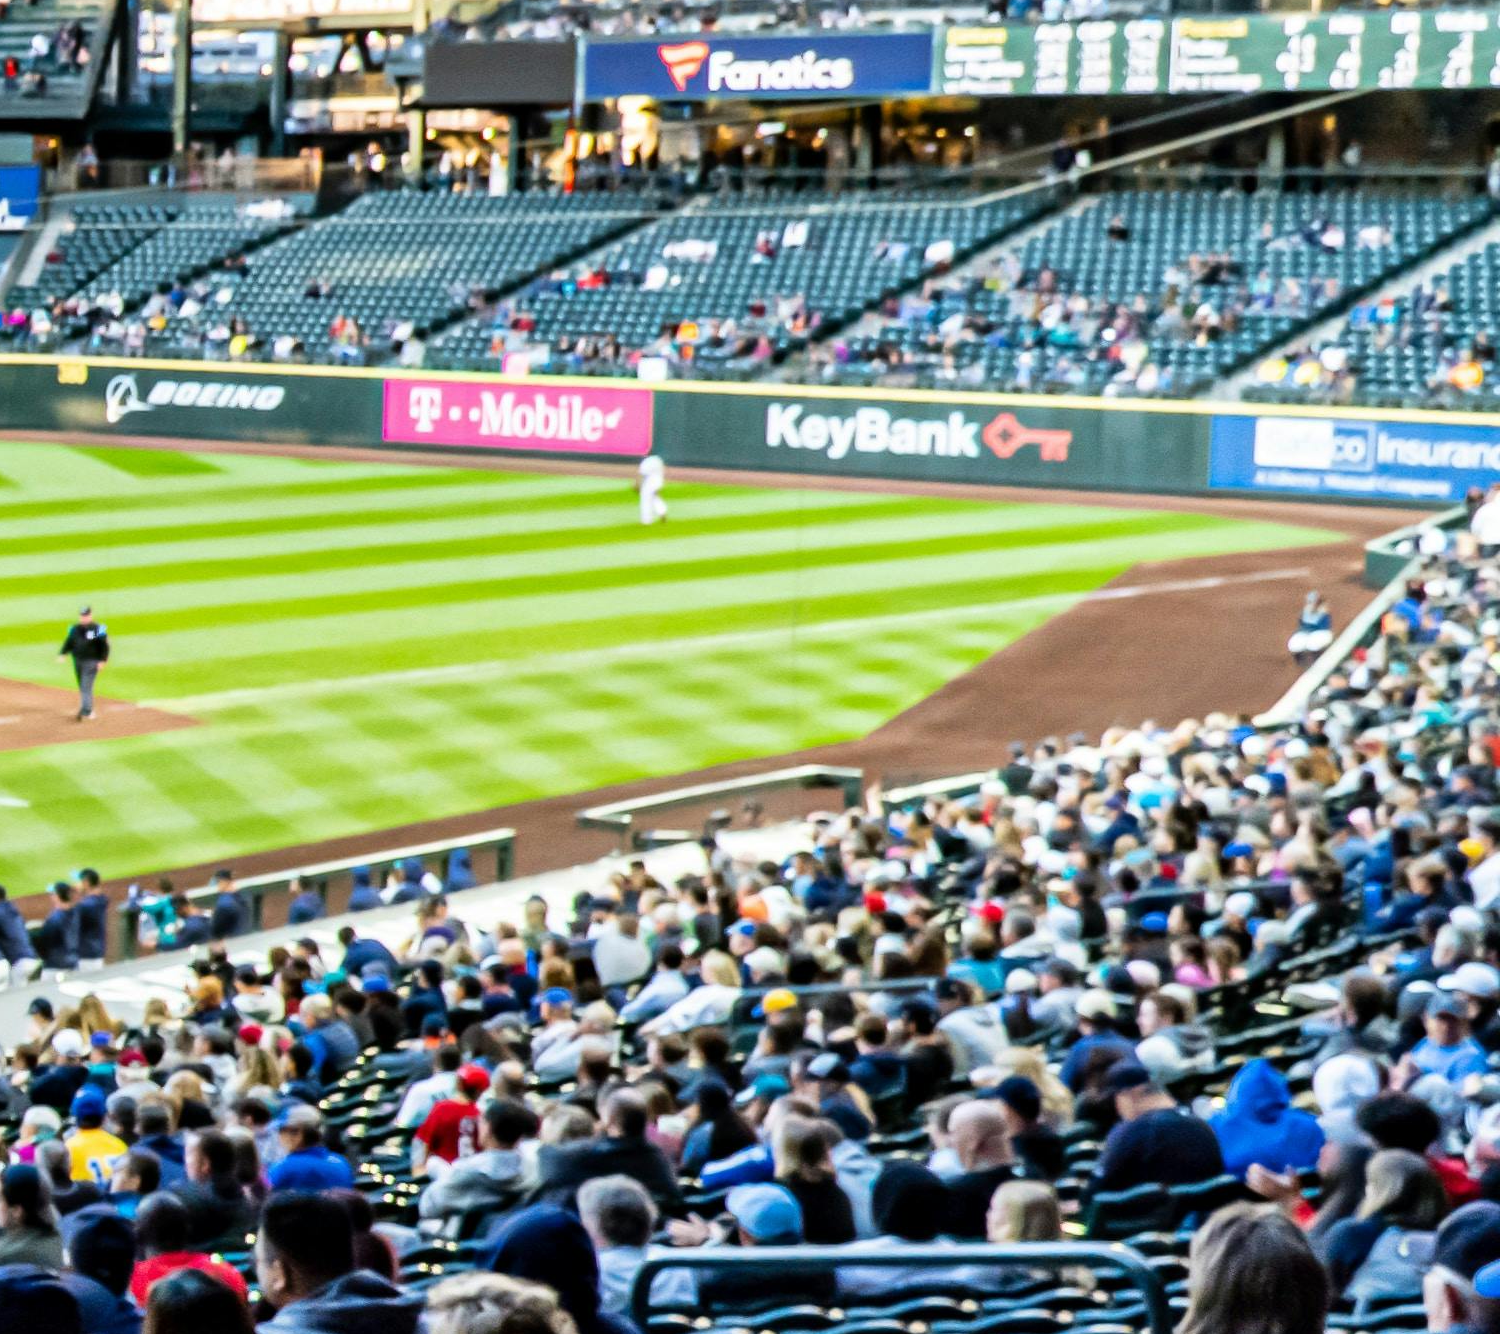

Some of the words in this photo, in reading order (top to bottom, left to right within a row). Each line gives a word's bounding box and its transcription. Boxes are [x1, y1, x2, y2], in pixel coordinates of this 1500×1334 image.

[709, 50, 853, 91] Fanatics
[147, 380, 284, 411] BOEING
[766, 404, 980, 459] KeyBank
